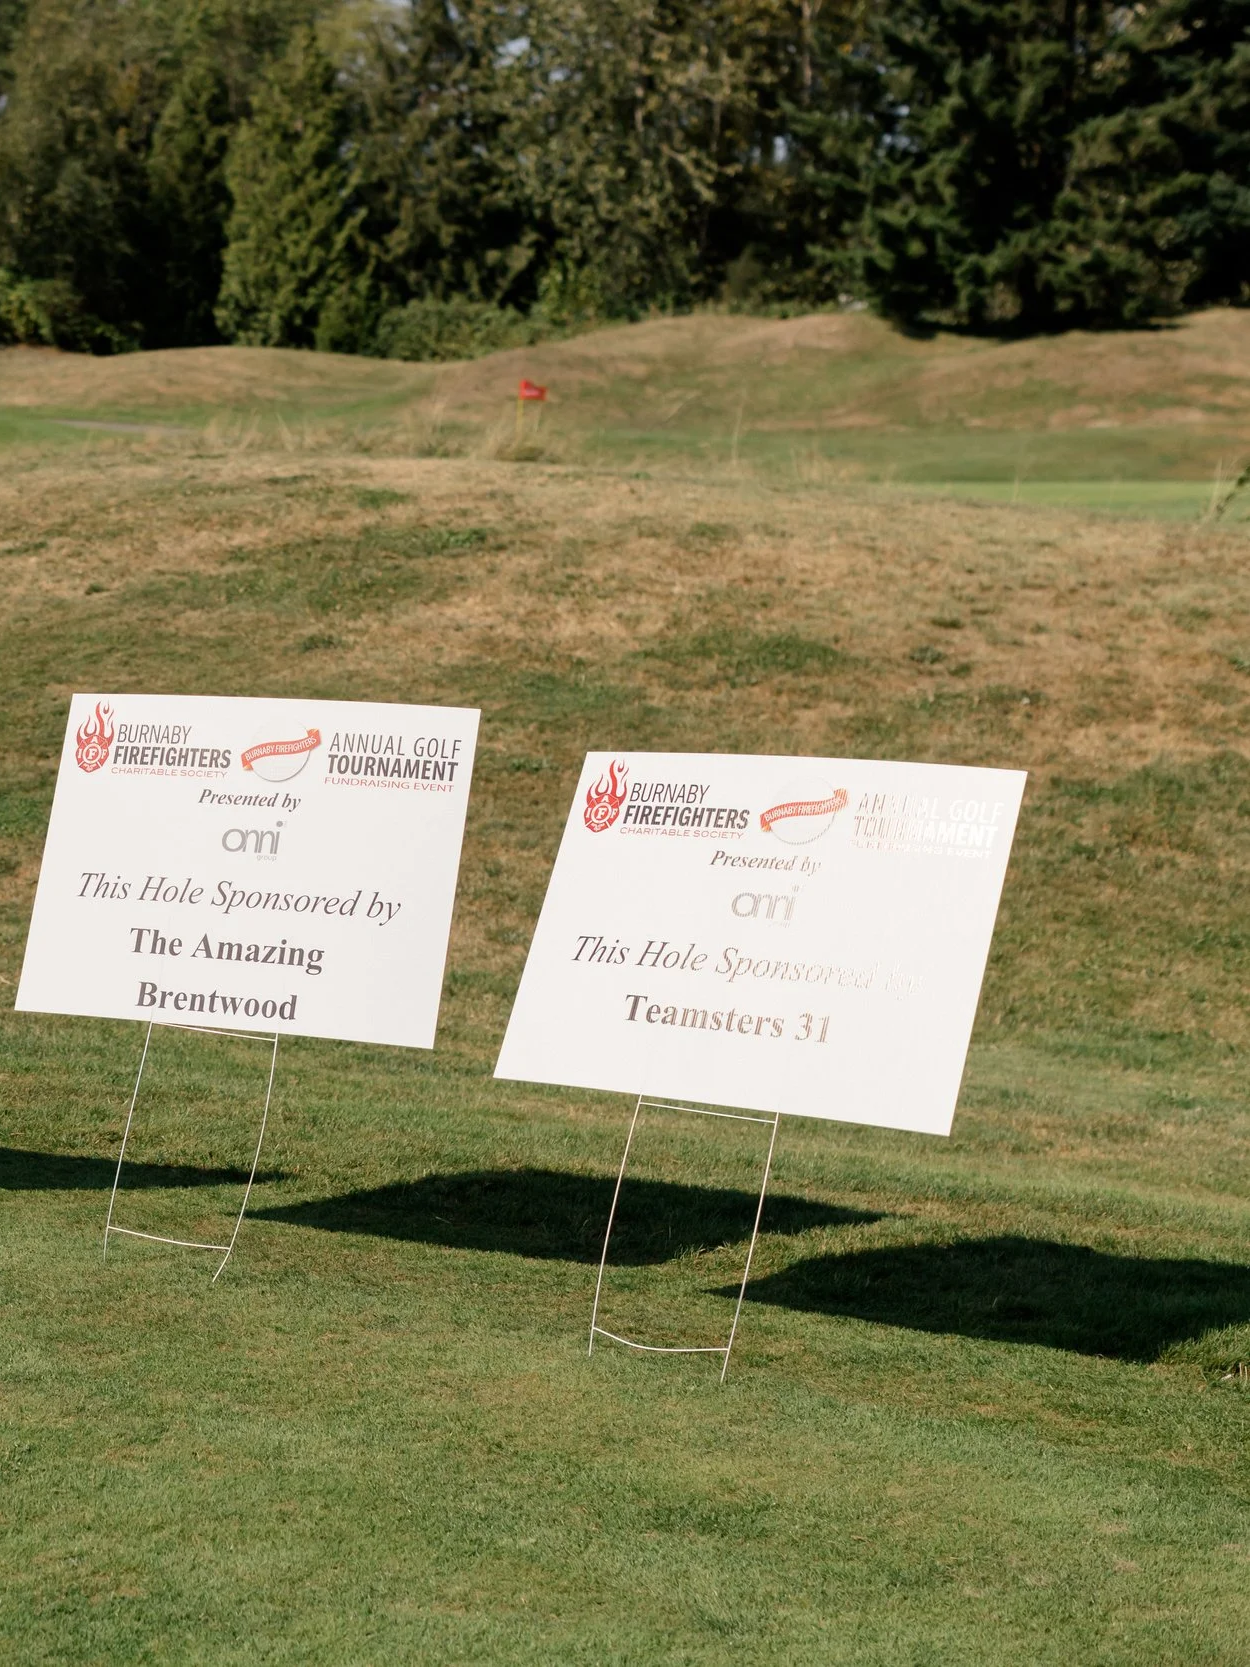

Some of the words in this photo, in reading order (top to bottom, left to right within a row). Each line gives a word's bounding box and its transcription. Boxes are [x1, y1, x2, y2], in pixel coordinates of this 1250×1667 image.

[117, 724, 192, 744] BURNABY
[329, 733, 405, 756] ANNUAL
[414, 737, 462, 758] GOLF
[113, 745, 232, 769] FIREFIGHTERS
[245, 745, 275, 761] BURNABY
[275, 735, 317, 754] FIREFIGHTERS
[111, 766, 179, 777] CHARITABLE
[180, 769, 228, 778] SOCIETY
[327, 753, 459, 782] TOURNAMENT
[324, 777, 410, 790] FUNDRAISING
[413, 783, 454, 792] EVENT
[630, 782, 710, 804] BURNABY
[198, 788, 279, 808] Presented
[281, 795, 301, 812] by
[950, 800, 1004, 824] GOLF
[623, 805, 750, 830] FIREFIGHTERS
[765, 807, 796, 822] BURNABY
[221, 821, 284, 854] onni
[619, 826, 692, 838] CHARITABLE
[693, 830, 744, 840] SOCIETY
[710, 850, 796, 871] Presented
[798, 858, 821, 876] by
[78, 873, 131, 900] This
[138, 877, 204, 905] Hole
[212, 881, 362, 916] Sponsored
[367, 894, 401, 925] by
[130, 927, 183, 955] The
[191, 934, 325, 975] Amazing
[571, 936, 630, 964] This
[637, 940, 708, 972] Hole
[715, 946, 880, 990] Sponsored
[137, 981, 297, 1020] Brentwood
[625, 995, 784, 1038] Teamsters
[795, 1013, 830, 1044] 31
